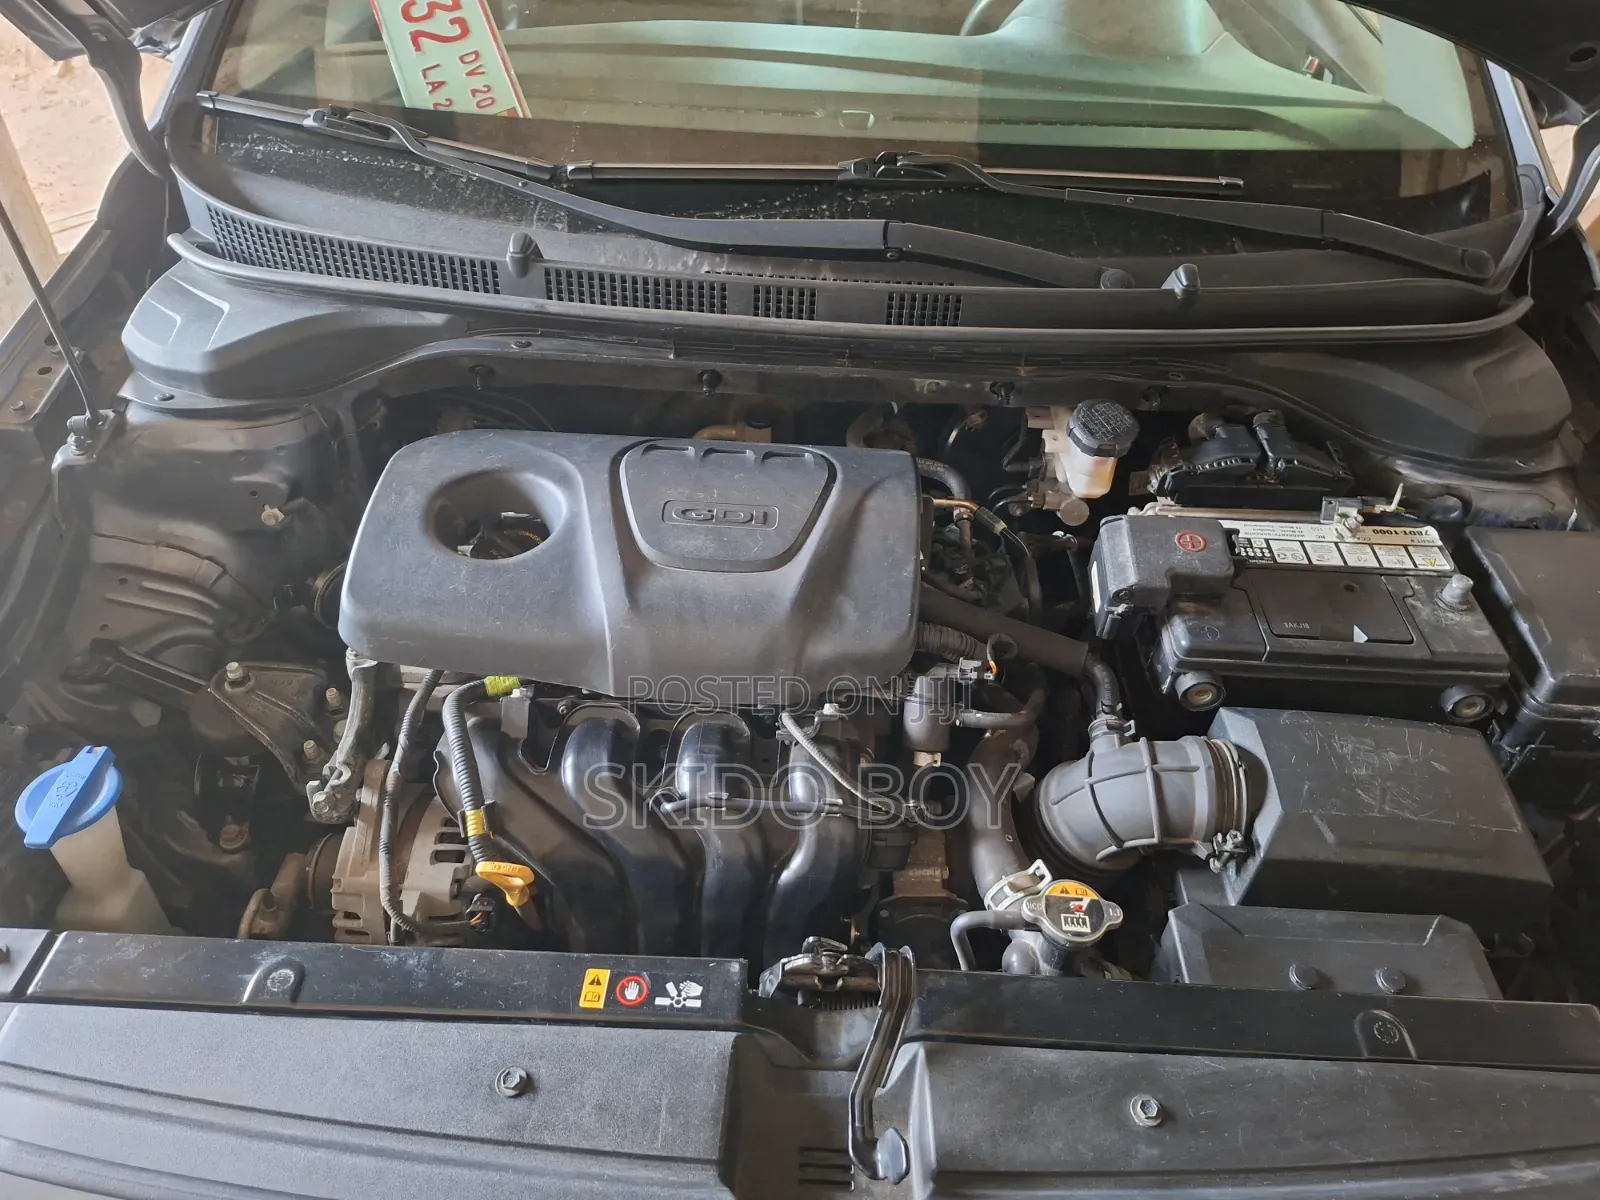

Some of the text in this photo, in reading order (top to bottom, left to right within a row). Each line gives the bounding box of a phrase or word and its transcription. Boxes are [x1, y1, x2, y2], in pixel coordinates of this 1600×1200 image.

[420, 63, 446, 95] LA
[458, 50, 496, 109] DV 20
[672, 507, 768, 525] GDI
